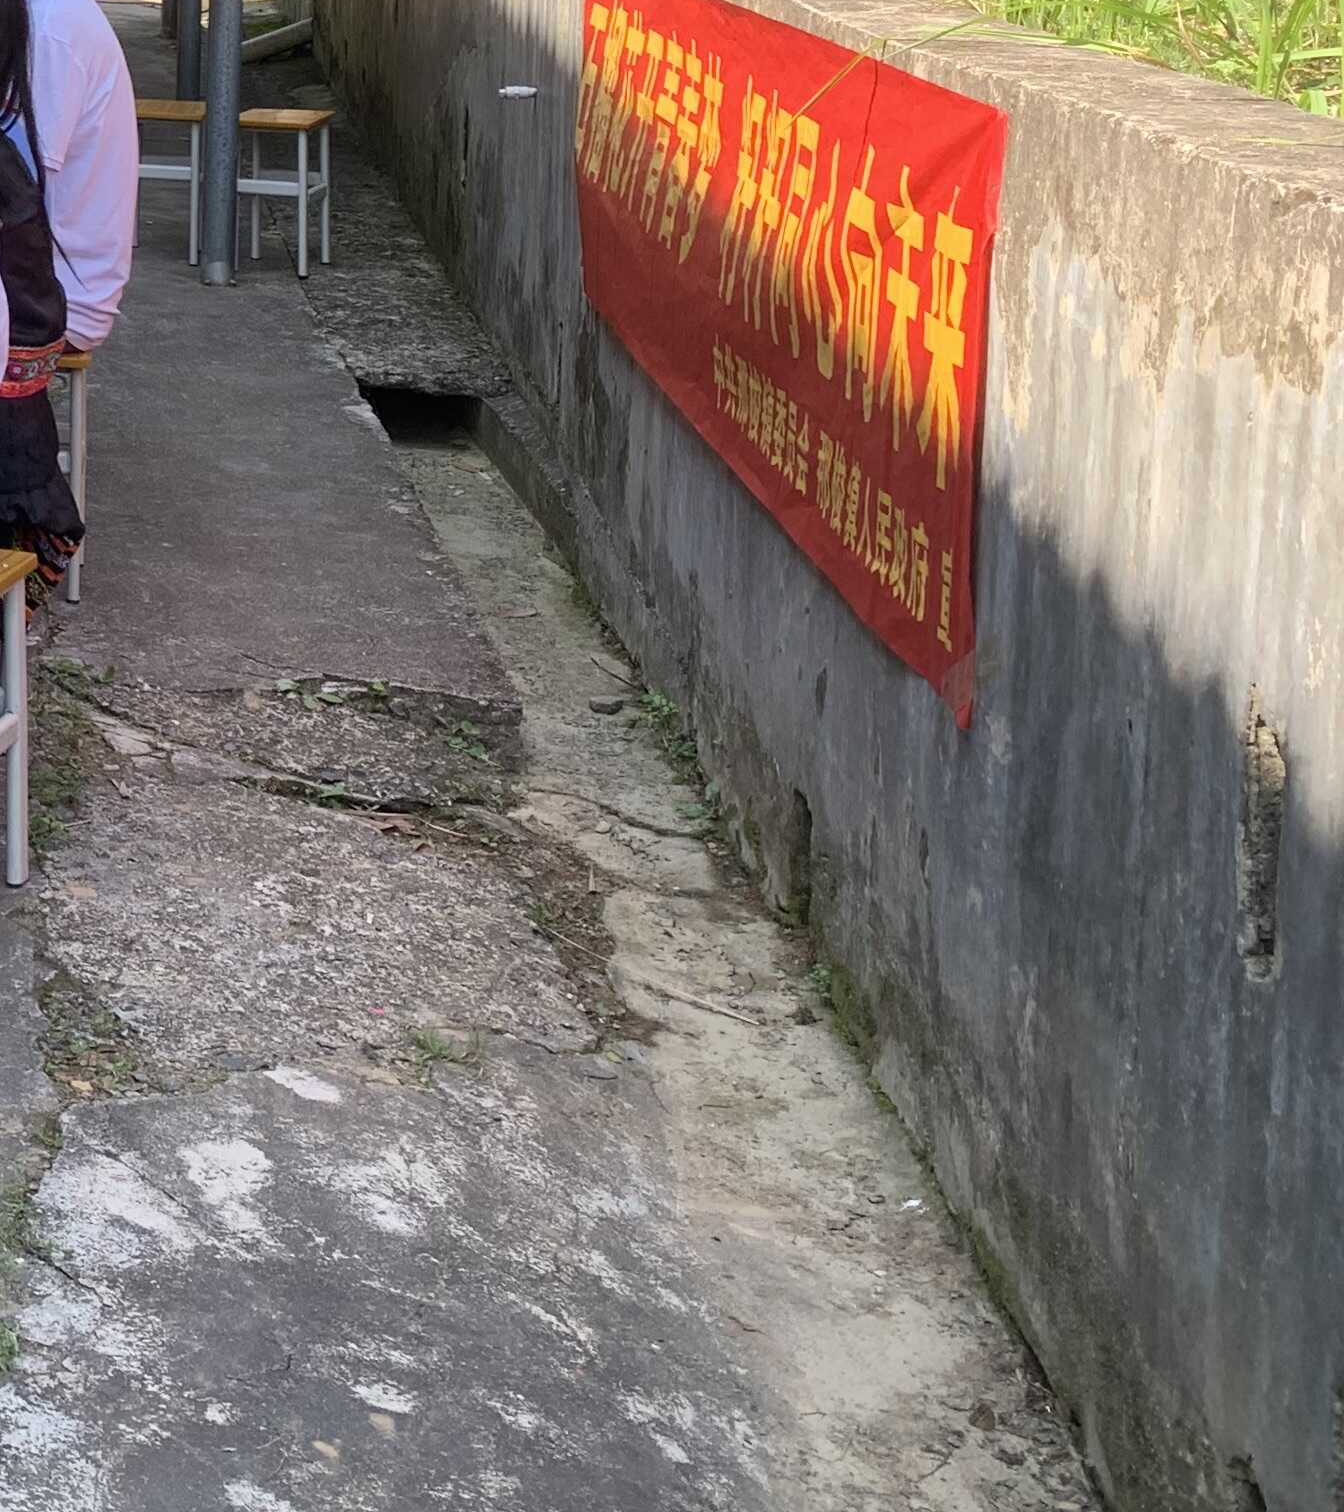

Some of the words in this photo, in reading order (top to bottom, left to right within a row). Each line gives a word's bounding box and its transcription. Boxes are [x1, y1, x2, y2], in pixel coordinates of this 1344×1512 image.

[718, 73, 974, 491] 籽籽同心向未来
